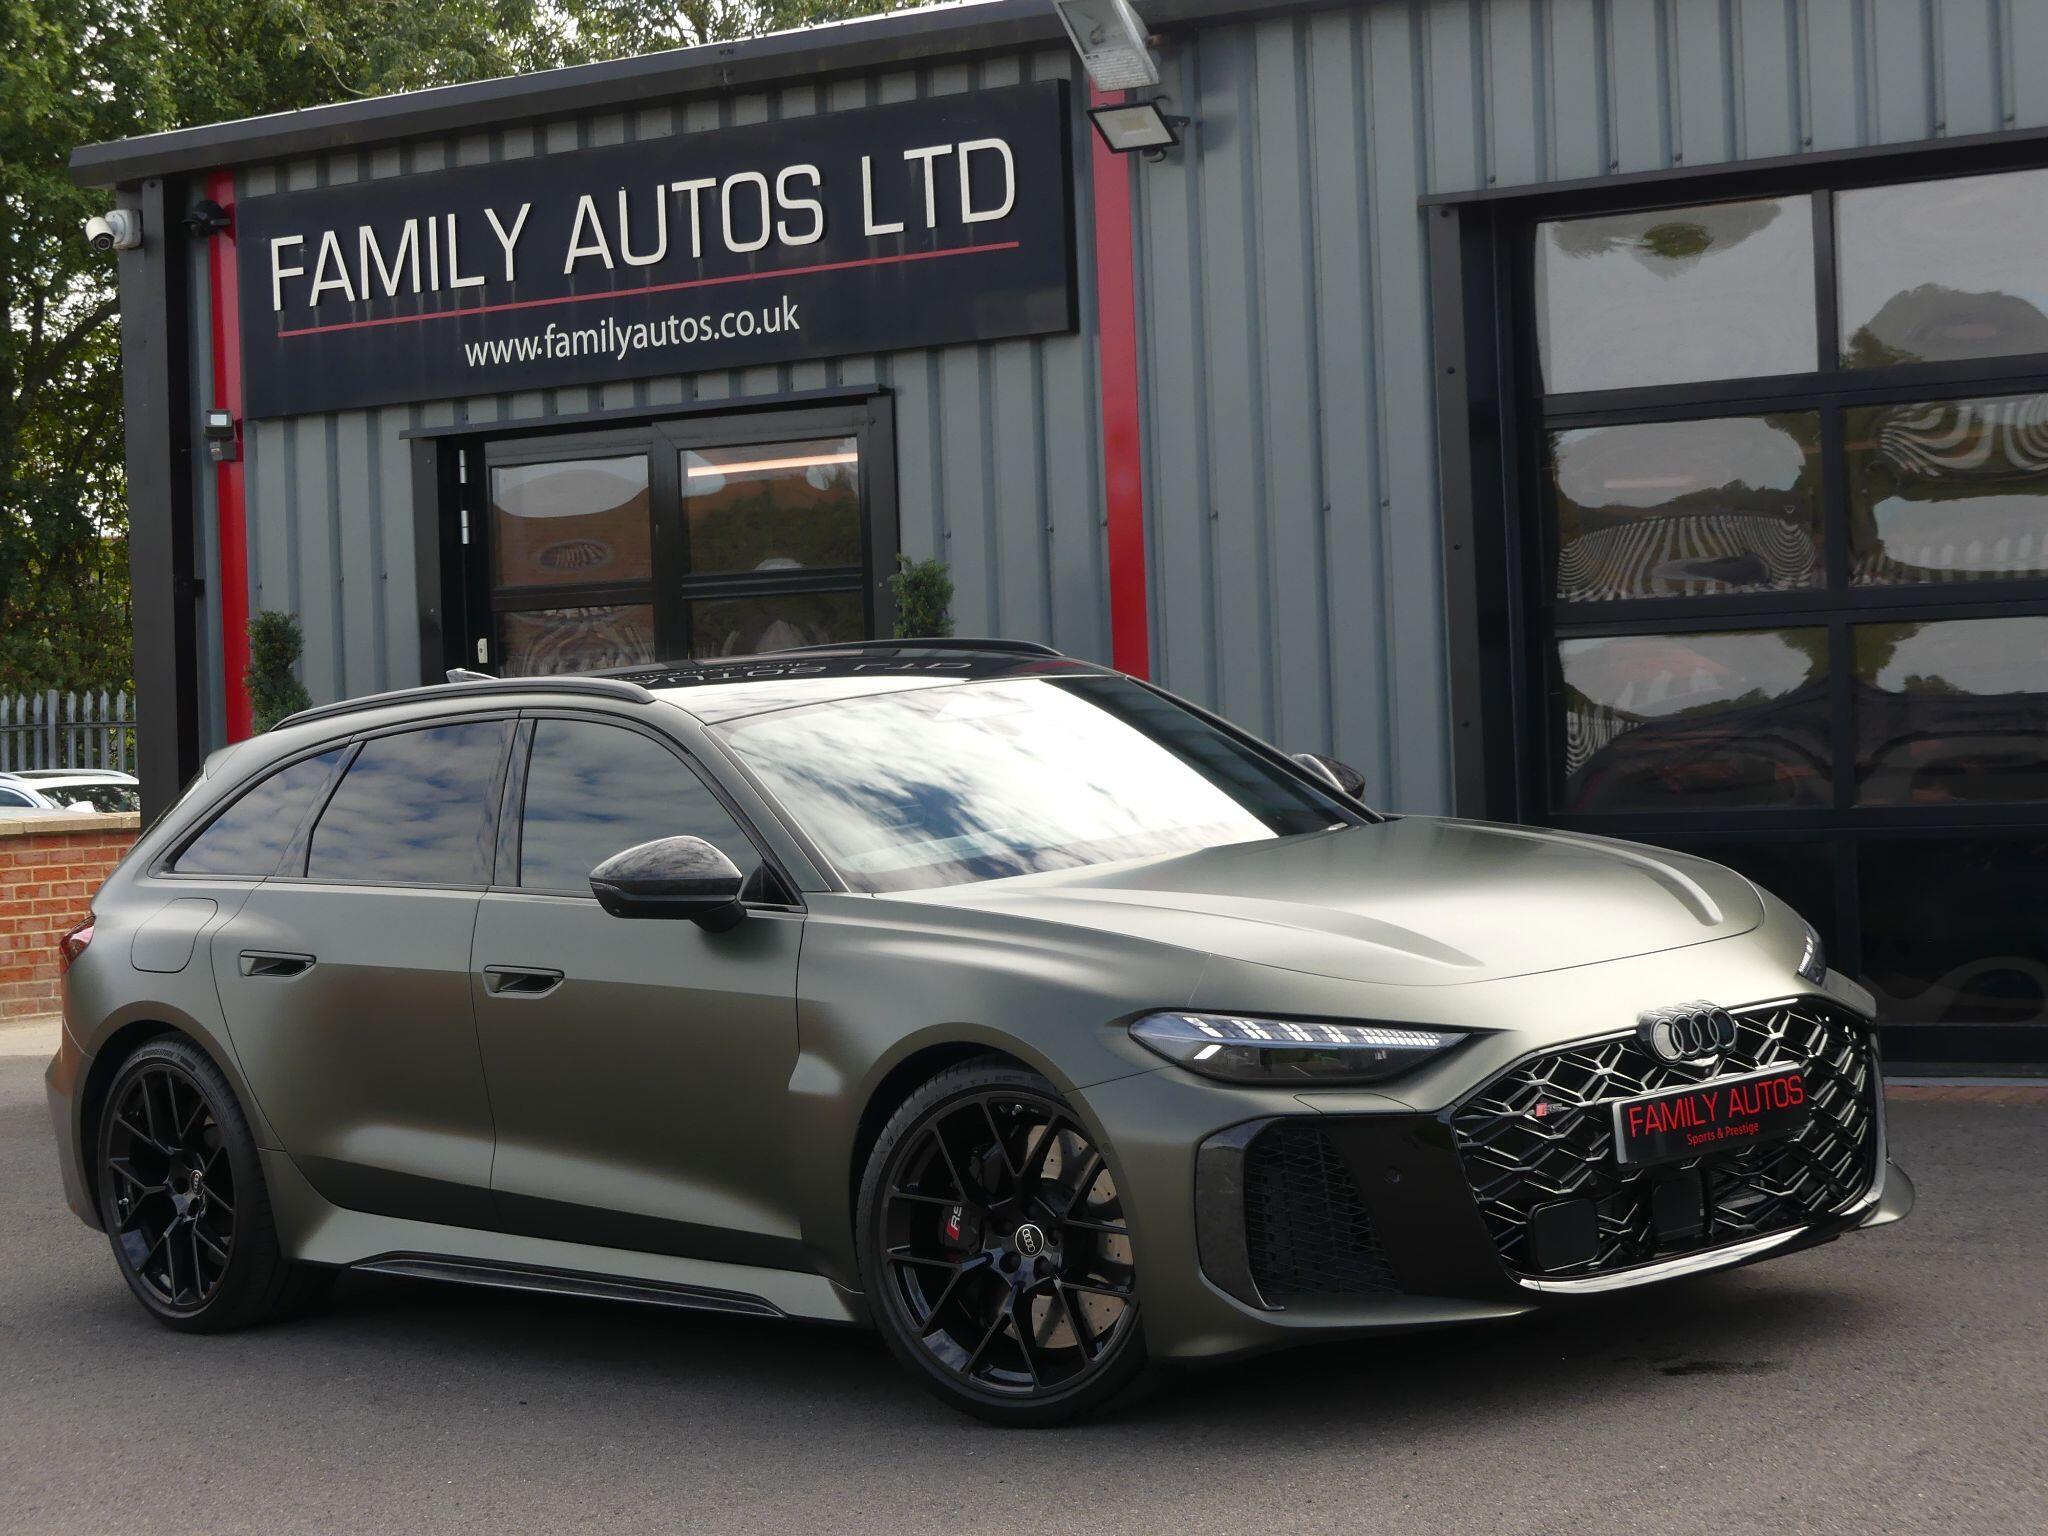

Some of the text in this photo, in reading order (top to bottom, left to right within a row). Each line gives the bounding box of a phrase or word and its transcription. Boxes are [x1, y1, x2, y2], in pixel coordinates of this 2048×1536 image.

[271, 138, 1016, 311] FAMILY AUTOS LTD
[464, 295, 801, 368] www.familyautos.co.uk
[1628, 1075, 1804, 1138] FAMILY AUTOS
[1686, 1121, 1759, 1147] Sports & Prestige
